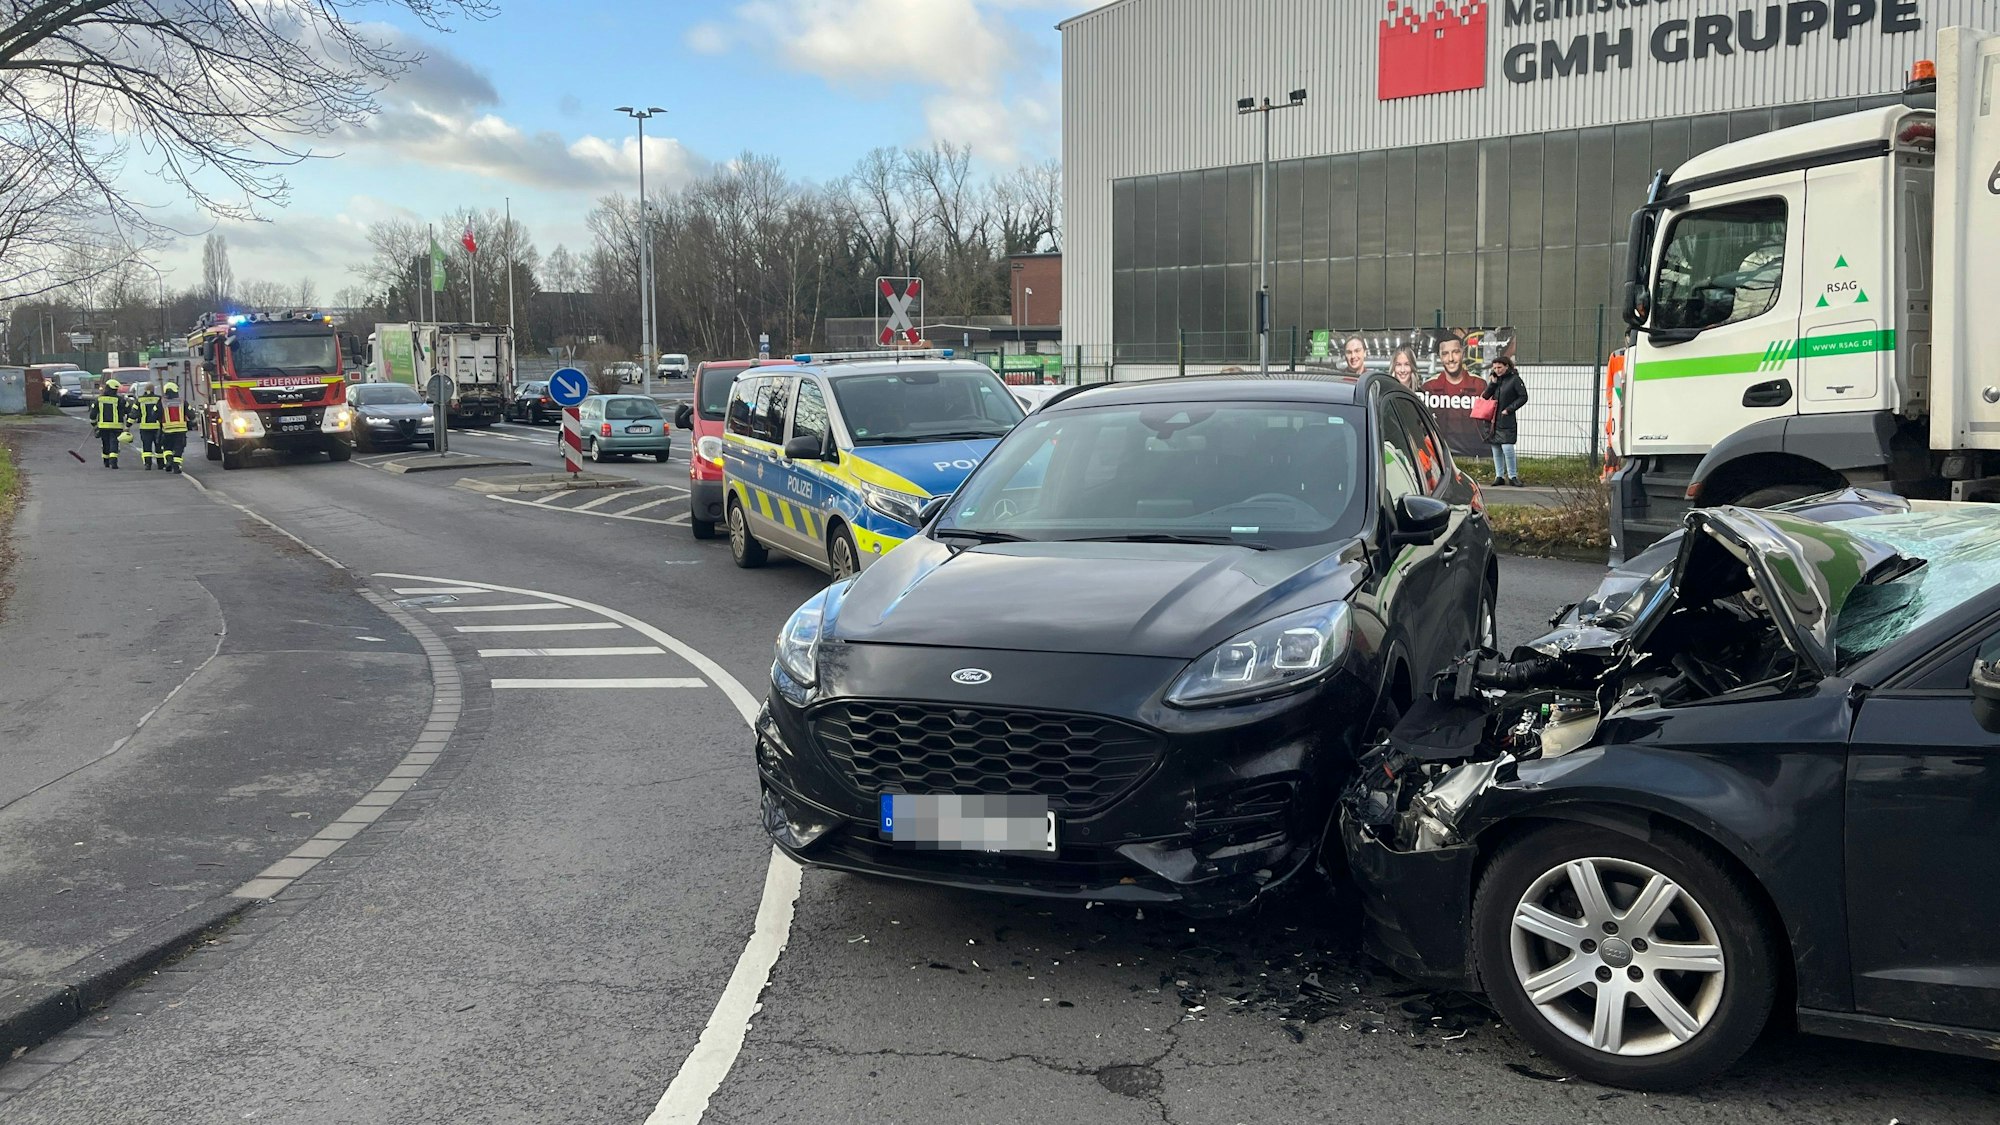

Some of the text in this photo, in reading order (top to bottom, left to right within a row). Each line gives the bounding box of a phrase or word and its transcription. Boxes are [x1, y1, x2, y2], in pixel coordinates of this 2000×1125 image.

[1503, 0, 1920, 83] GMH GRUPPE
[1827, 280, 1857, 293] RSAG
[1813, 340, 1872, 351] WWW.RSAG.DE
[257, 376, 321, 387] FEUERWEHR
[787, 474, 813, 500] POLIZEI
[960, 671, 983, 681] Ford
[885, 818, 892, 827] D
